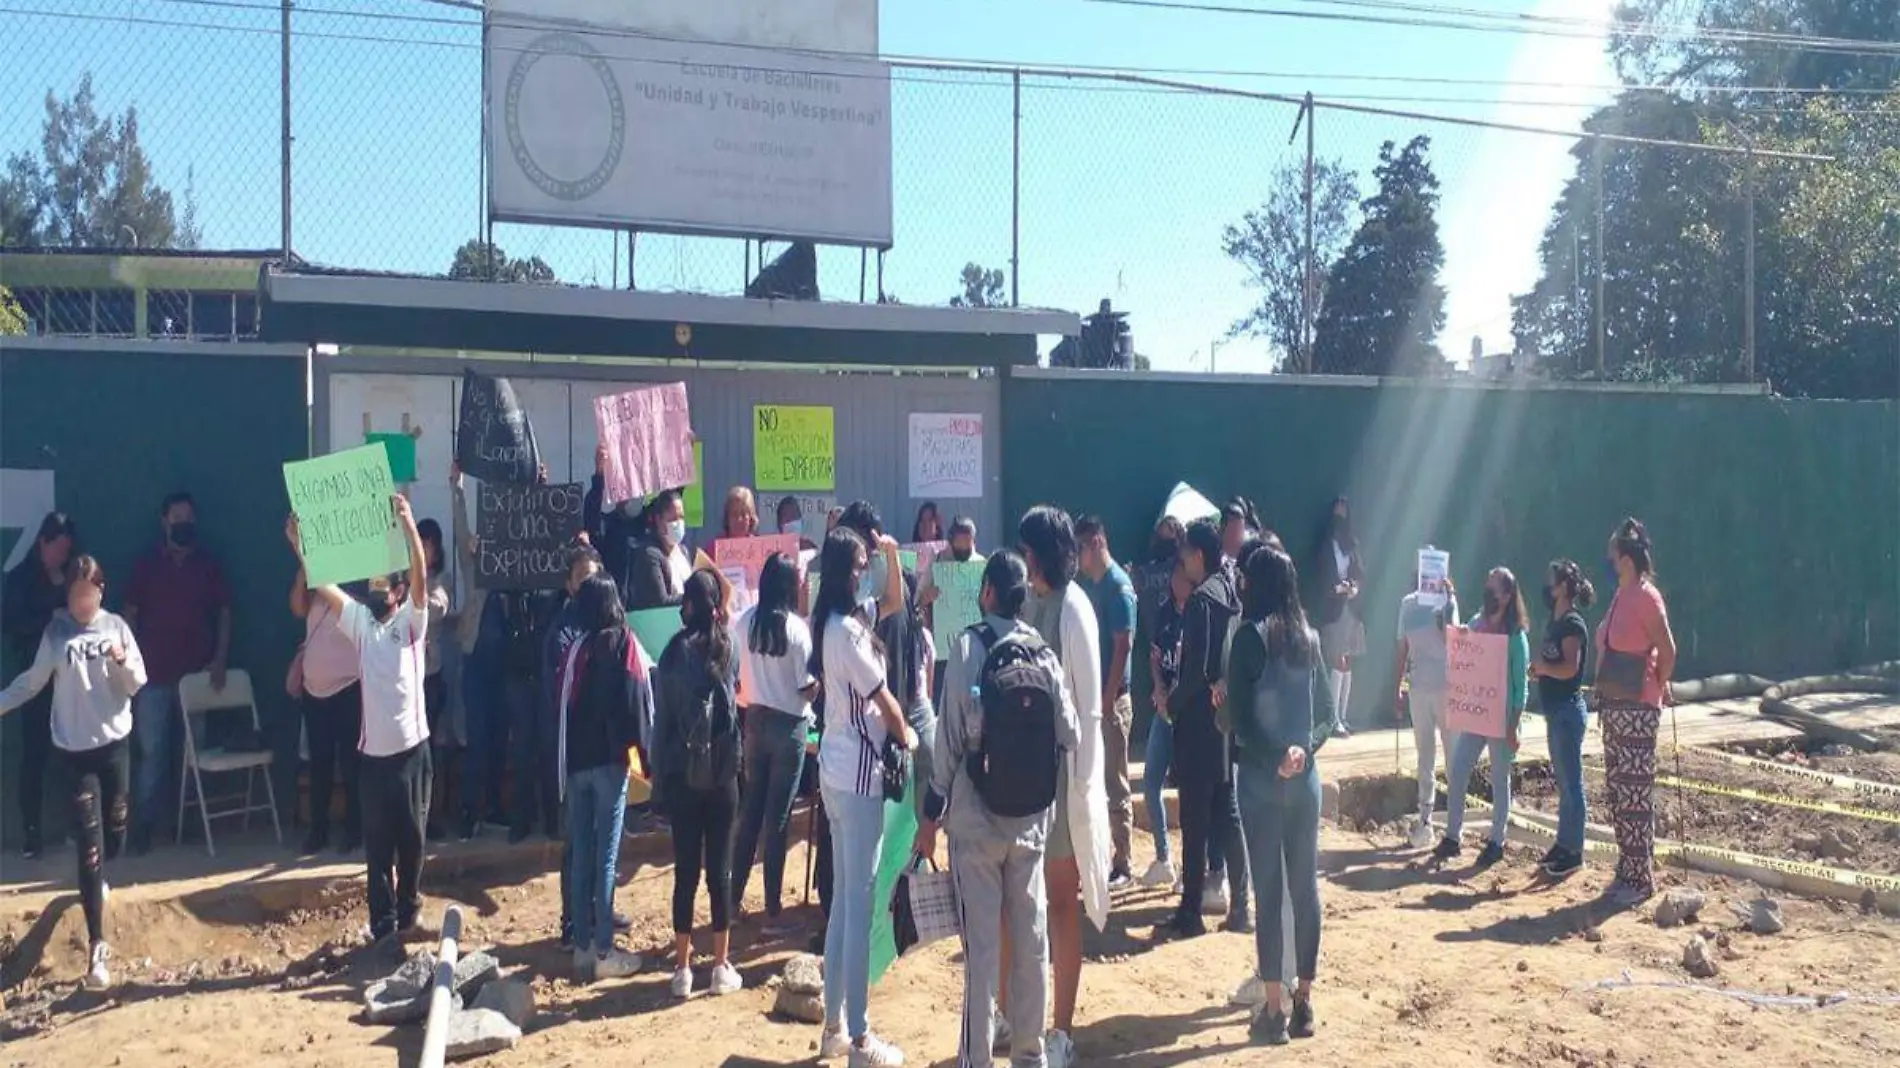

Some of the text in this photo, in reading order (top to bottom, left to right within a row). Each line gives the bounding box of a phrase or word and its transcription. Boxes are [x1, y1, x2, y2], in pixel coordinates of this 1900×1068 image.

[679, 58, 740, 79] Escuela
[743, 65, 761, 83] de
[708, 92, 718, 111] y
[722, 90, 786, 119] Trabajo
[757, 408, 779, 432] NO
